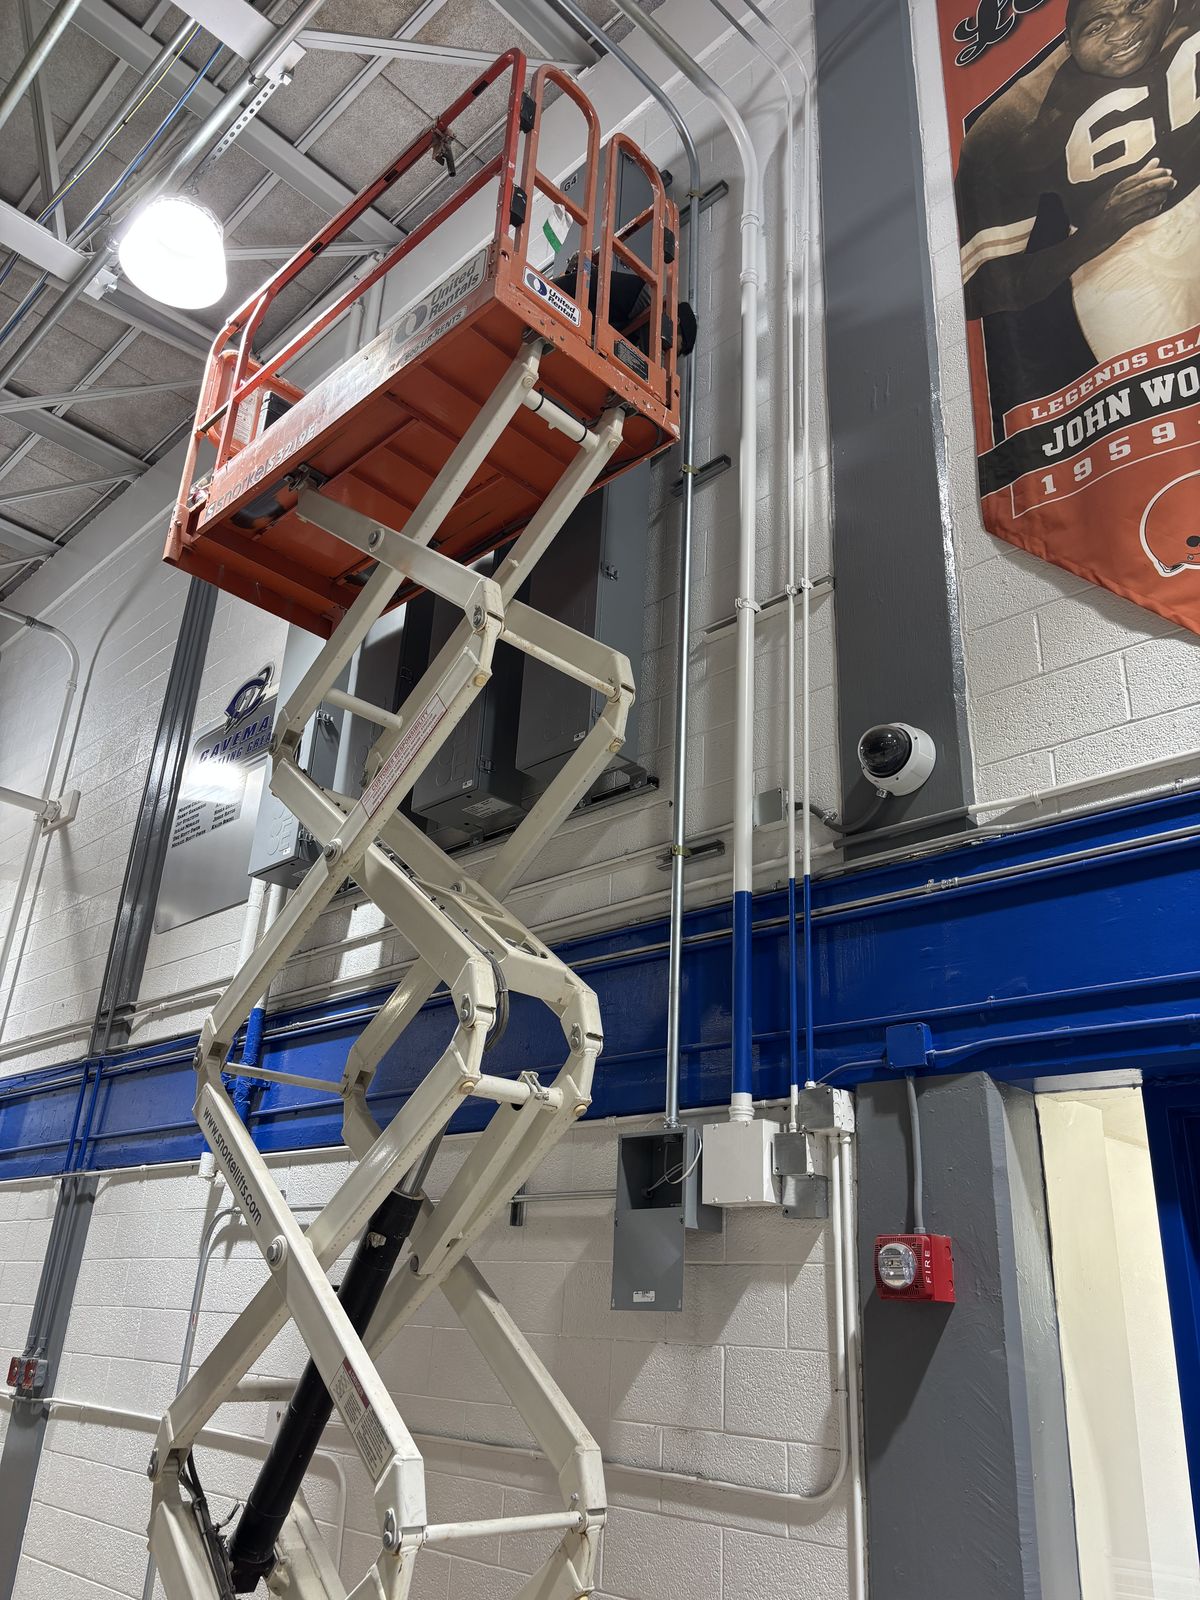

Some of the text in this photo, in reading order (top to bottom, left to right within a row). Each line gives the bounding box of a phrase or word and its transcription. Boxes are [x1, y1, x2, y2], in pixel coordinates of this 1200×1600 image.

[429, 274, 480, 320] Rentals
[431, 260, 477, 306] United
[549, 289, 576, 314] United
[548, 296, 577, 322] Rentals
[1031, 352, 1148, 420] LEGENDS
[1042, 366, 1200, 457] JOHN WO
[200, 715, 271, 762] CAVEMA
[203, 1107, 262, 1226] www.snorkellifts.com
[924, 1250, 932, 1284] FIRE
